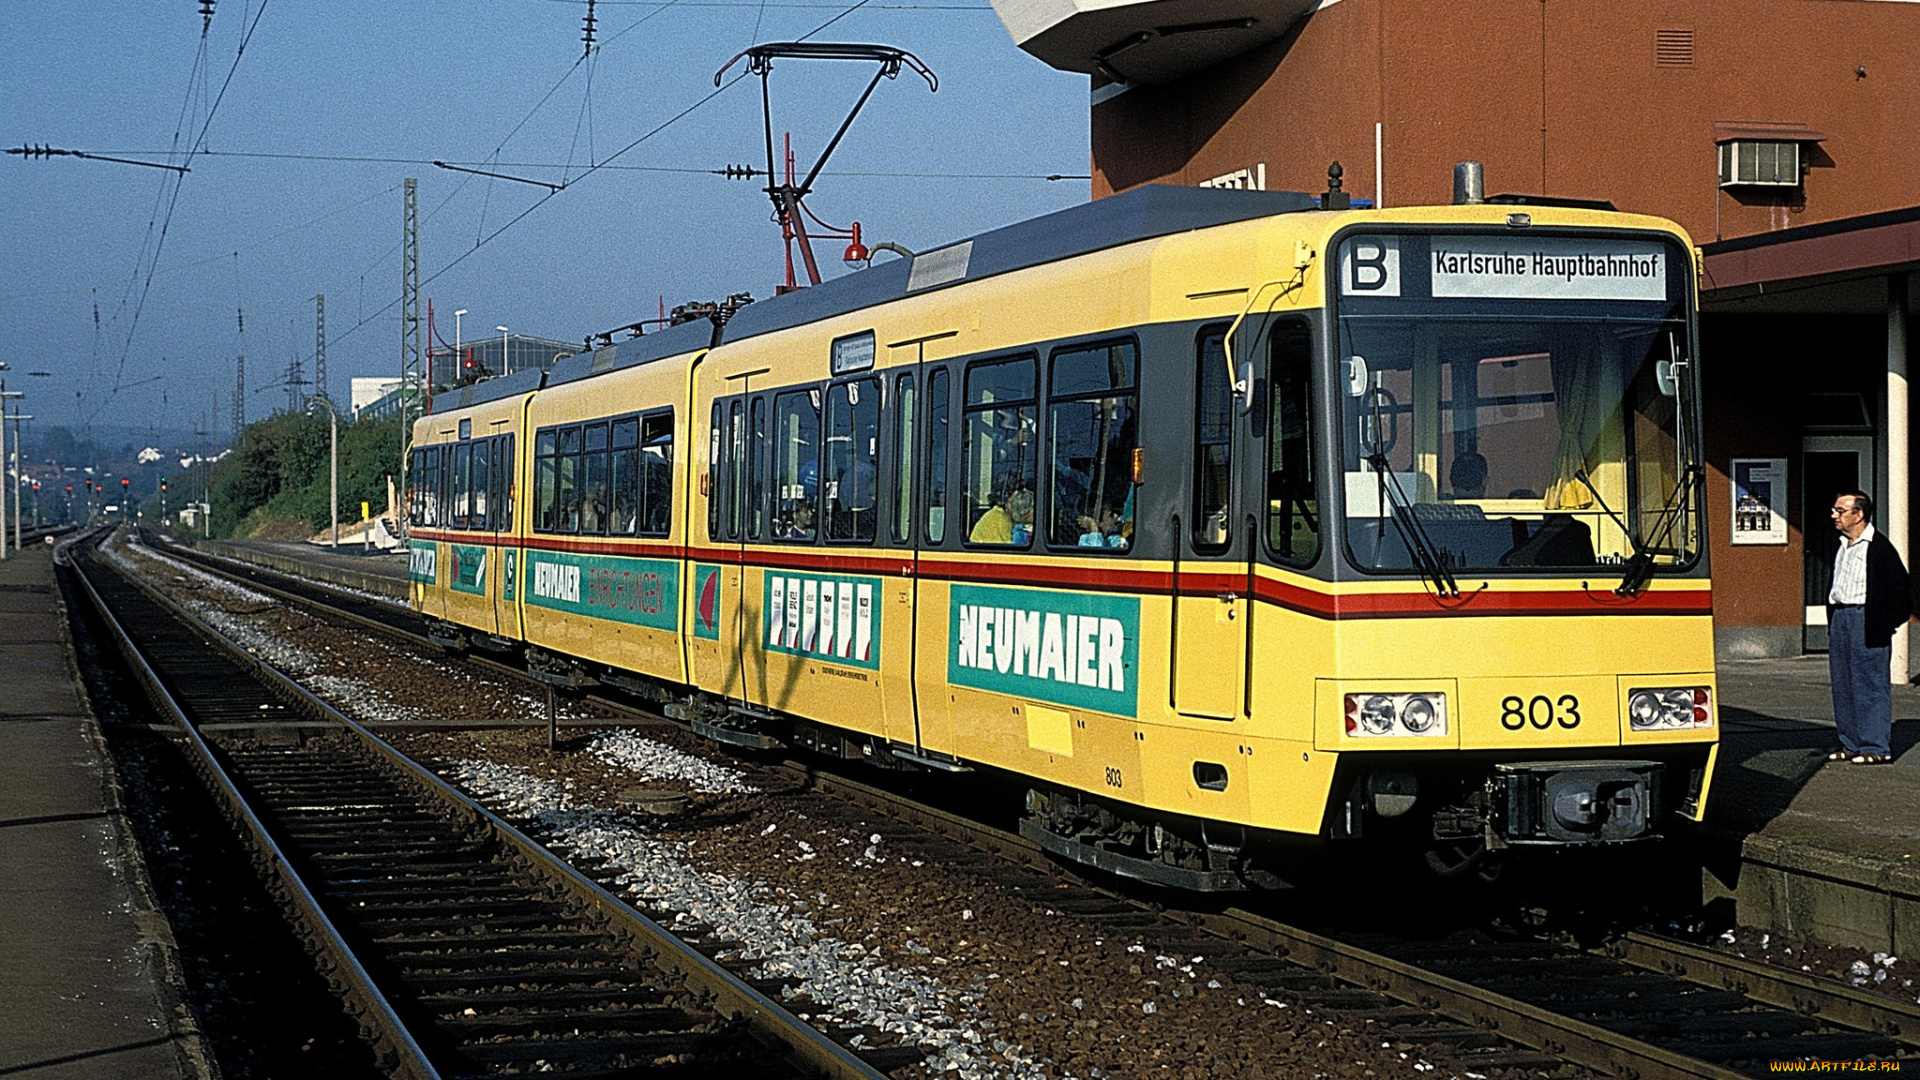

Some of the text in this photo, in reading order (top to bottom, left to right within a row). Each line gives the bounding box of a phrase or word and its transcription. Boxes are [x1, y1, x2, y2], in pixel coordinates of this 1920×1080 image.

[1350, 238, 1388, 291] B
[1435, 250, 1658, 282] Karlsruhe Hauptbahnhof
[534, 561, 663, 615] NEUMAIER EINRICHTUNGEN
[958, 604, 1125, 692] NEUMAIER
[1501, 694, 1581, 730] 803
[1105, 766, 1122, 788] 803
